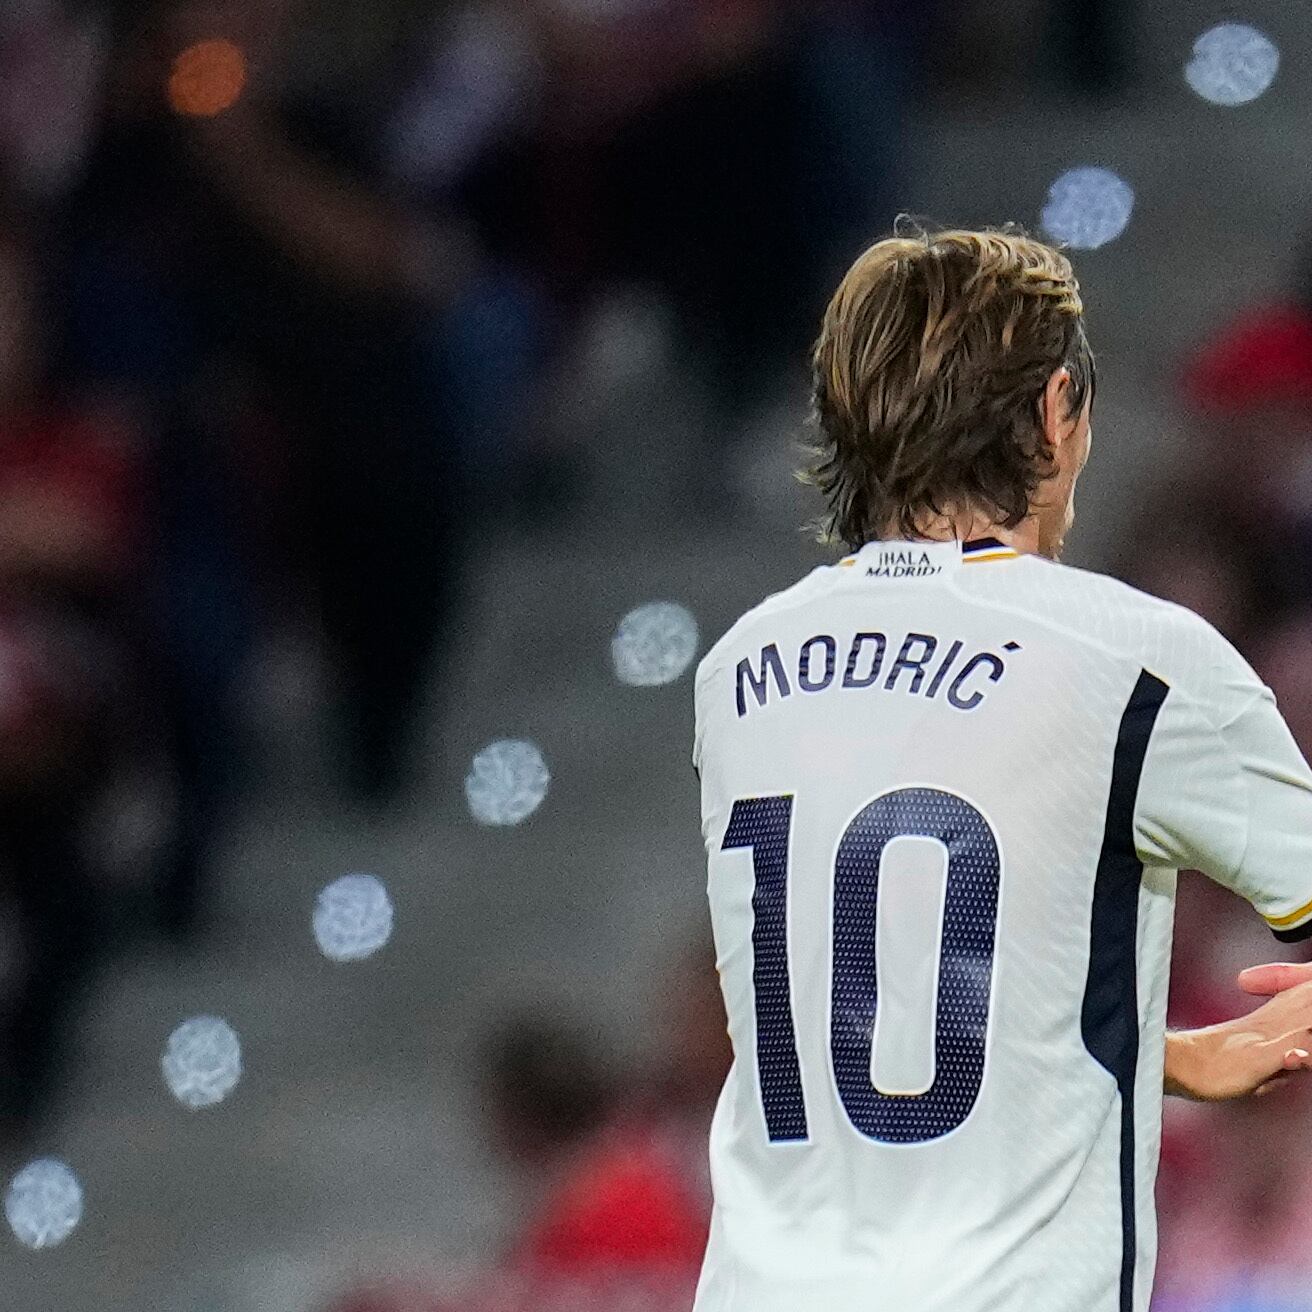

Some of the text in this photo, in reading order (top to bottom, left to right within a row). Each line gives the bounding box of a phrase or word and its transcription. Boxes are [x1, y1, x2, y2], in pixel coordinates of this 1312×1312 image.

[865, 565, 942, 578] MADRID!
[734, 630, 1023, 719] MODRIĆ
[720, 786, 1002, 1146] 10
